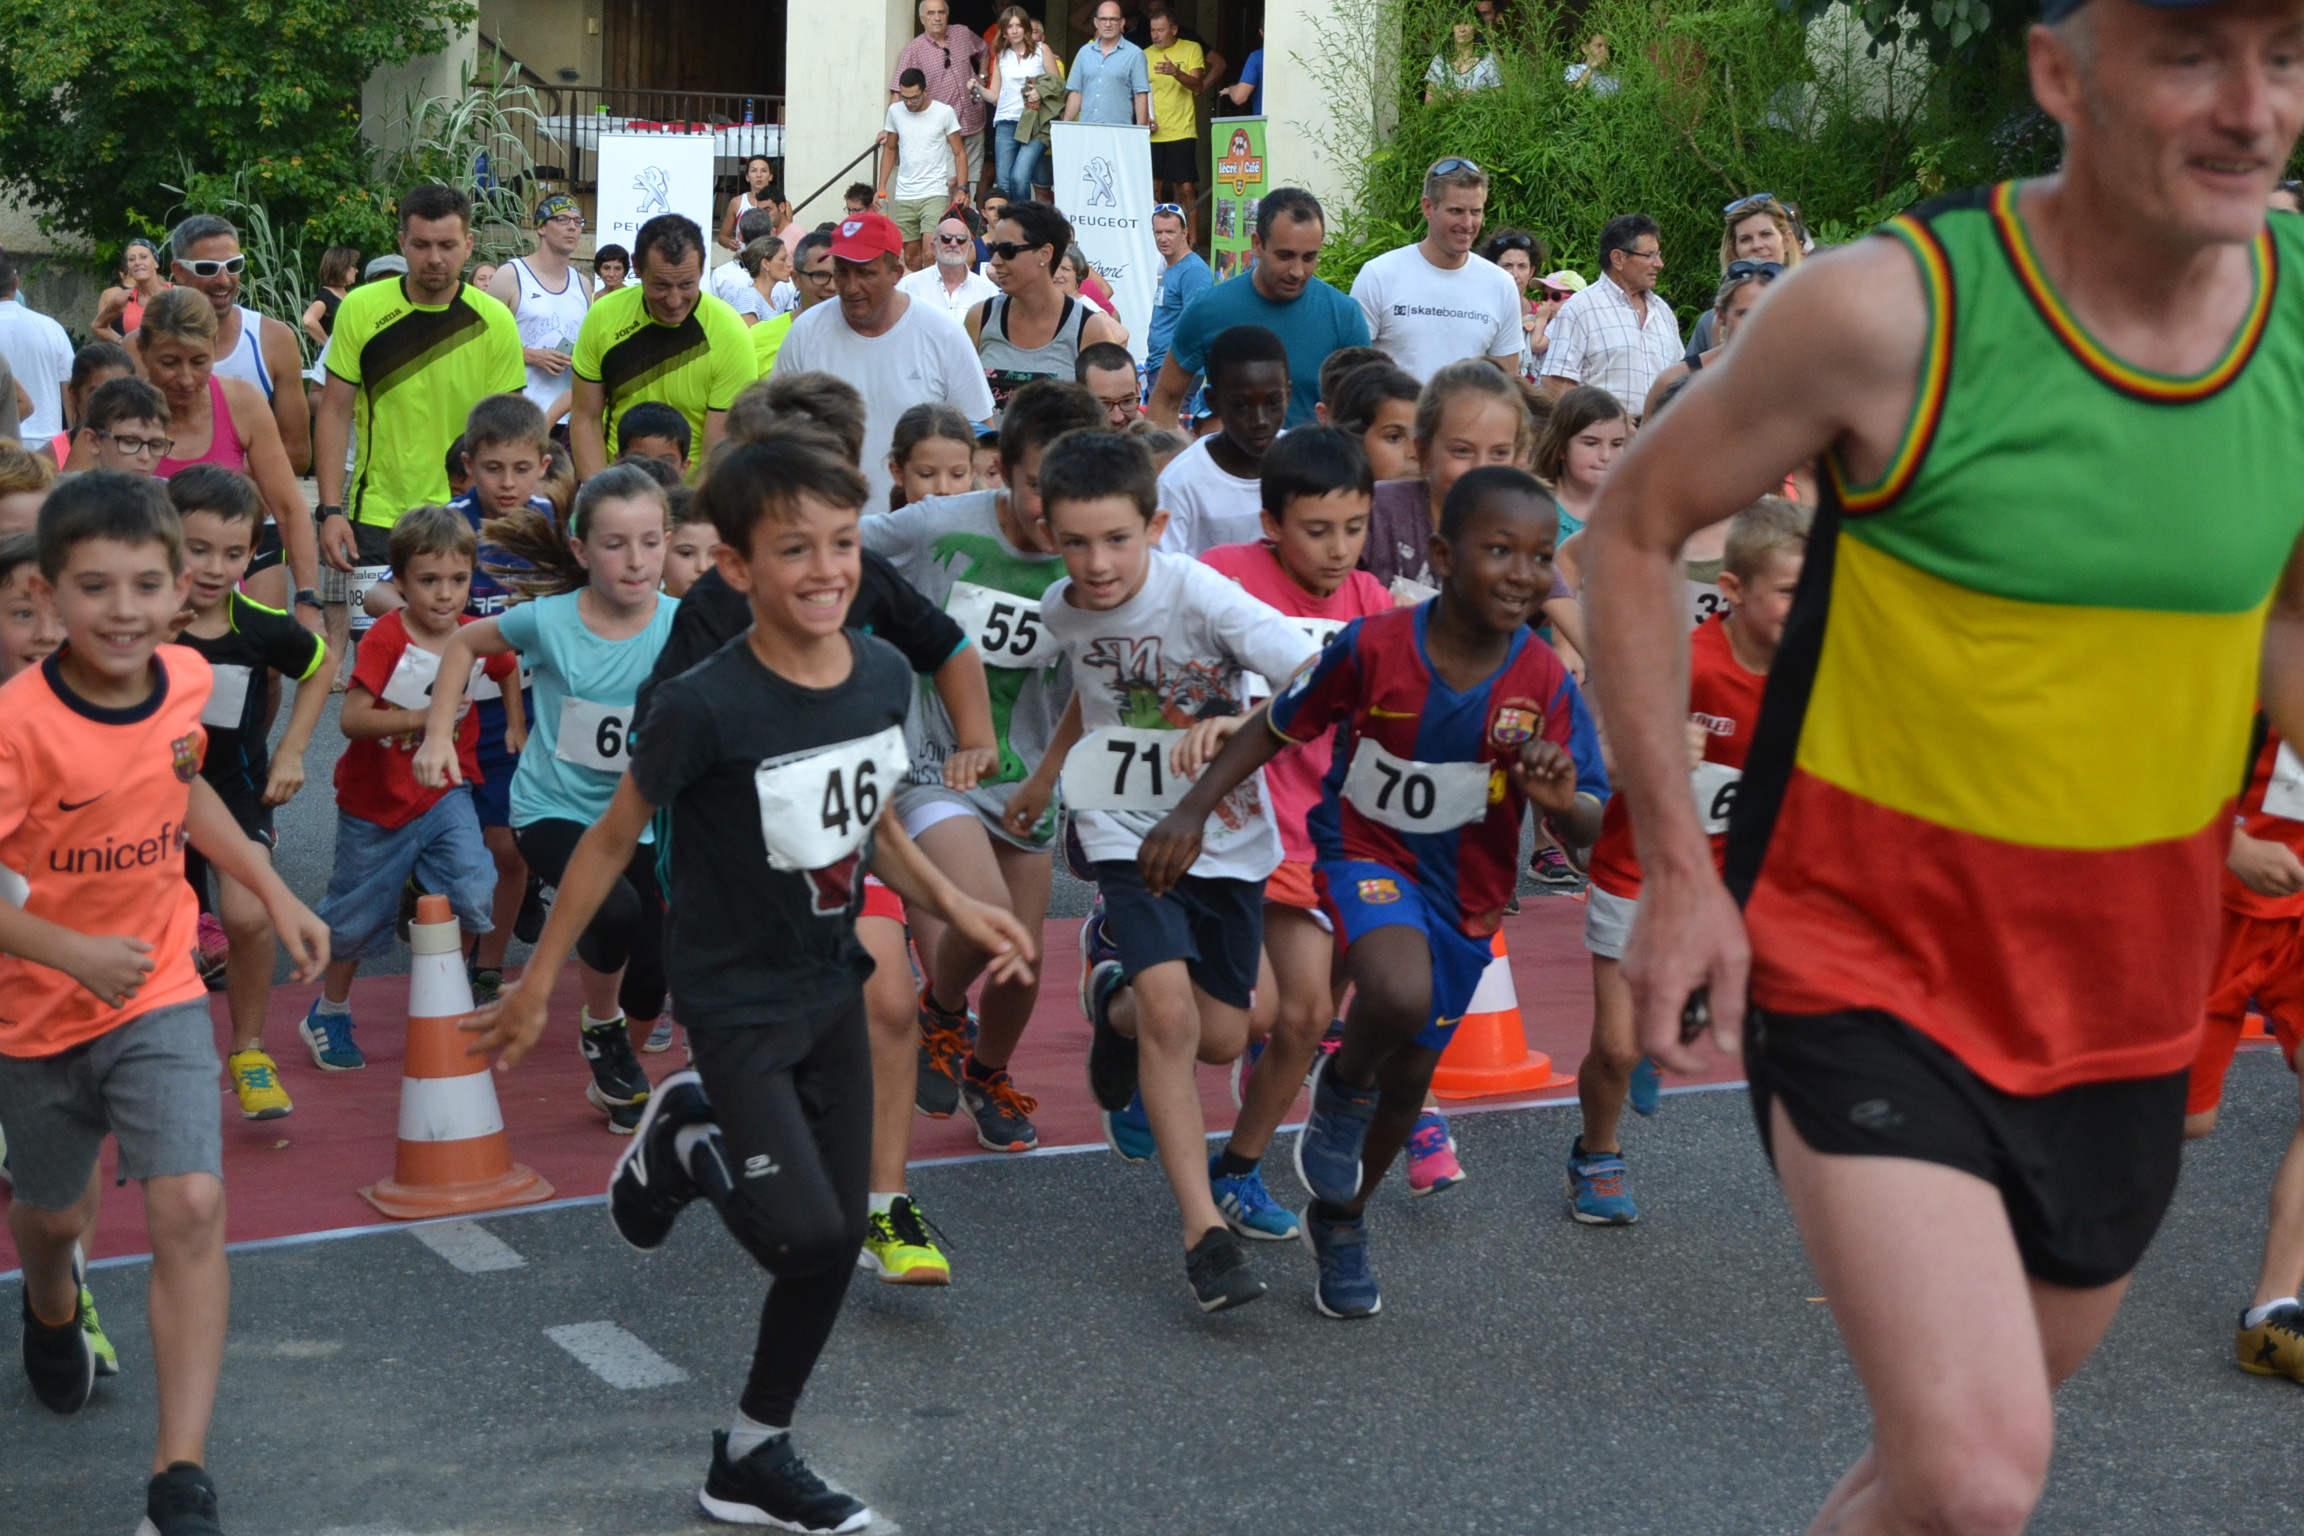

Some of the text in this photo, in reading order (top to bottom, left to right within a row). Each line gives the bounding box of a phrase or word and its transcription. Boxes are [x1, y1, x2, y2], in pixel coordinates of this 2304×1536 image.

[1069, 214, 1139, 229] PEUGEOT
[1410, 304, 1489, 324] skateboarding
[981, 601, 1042, 656] 55
[1108, 739, 1164, 796] 71
[1375, 758, 1436, 820] 70
[821, 759, 879, 837] 46
[49, 822, 171, 873] unicef
